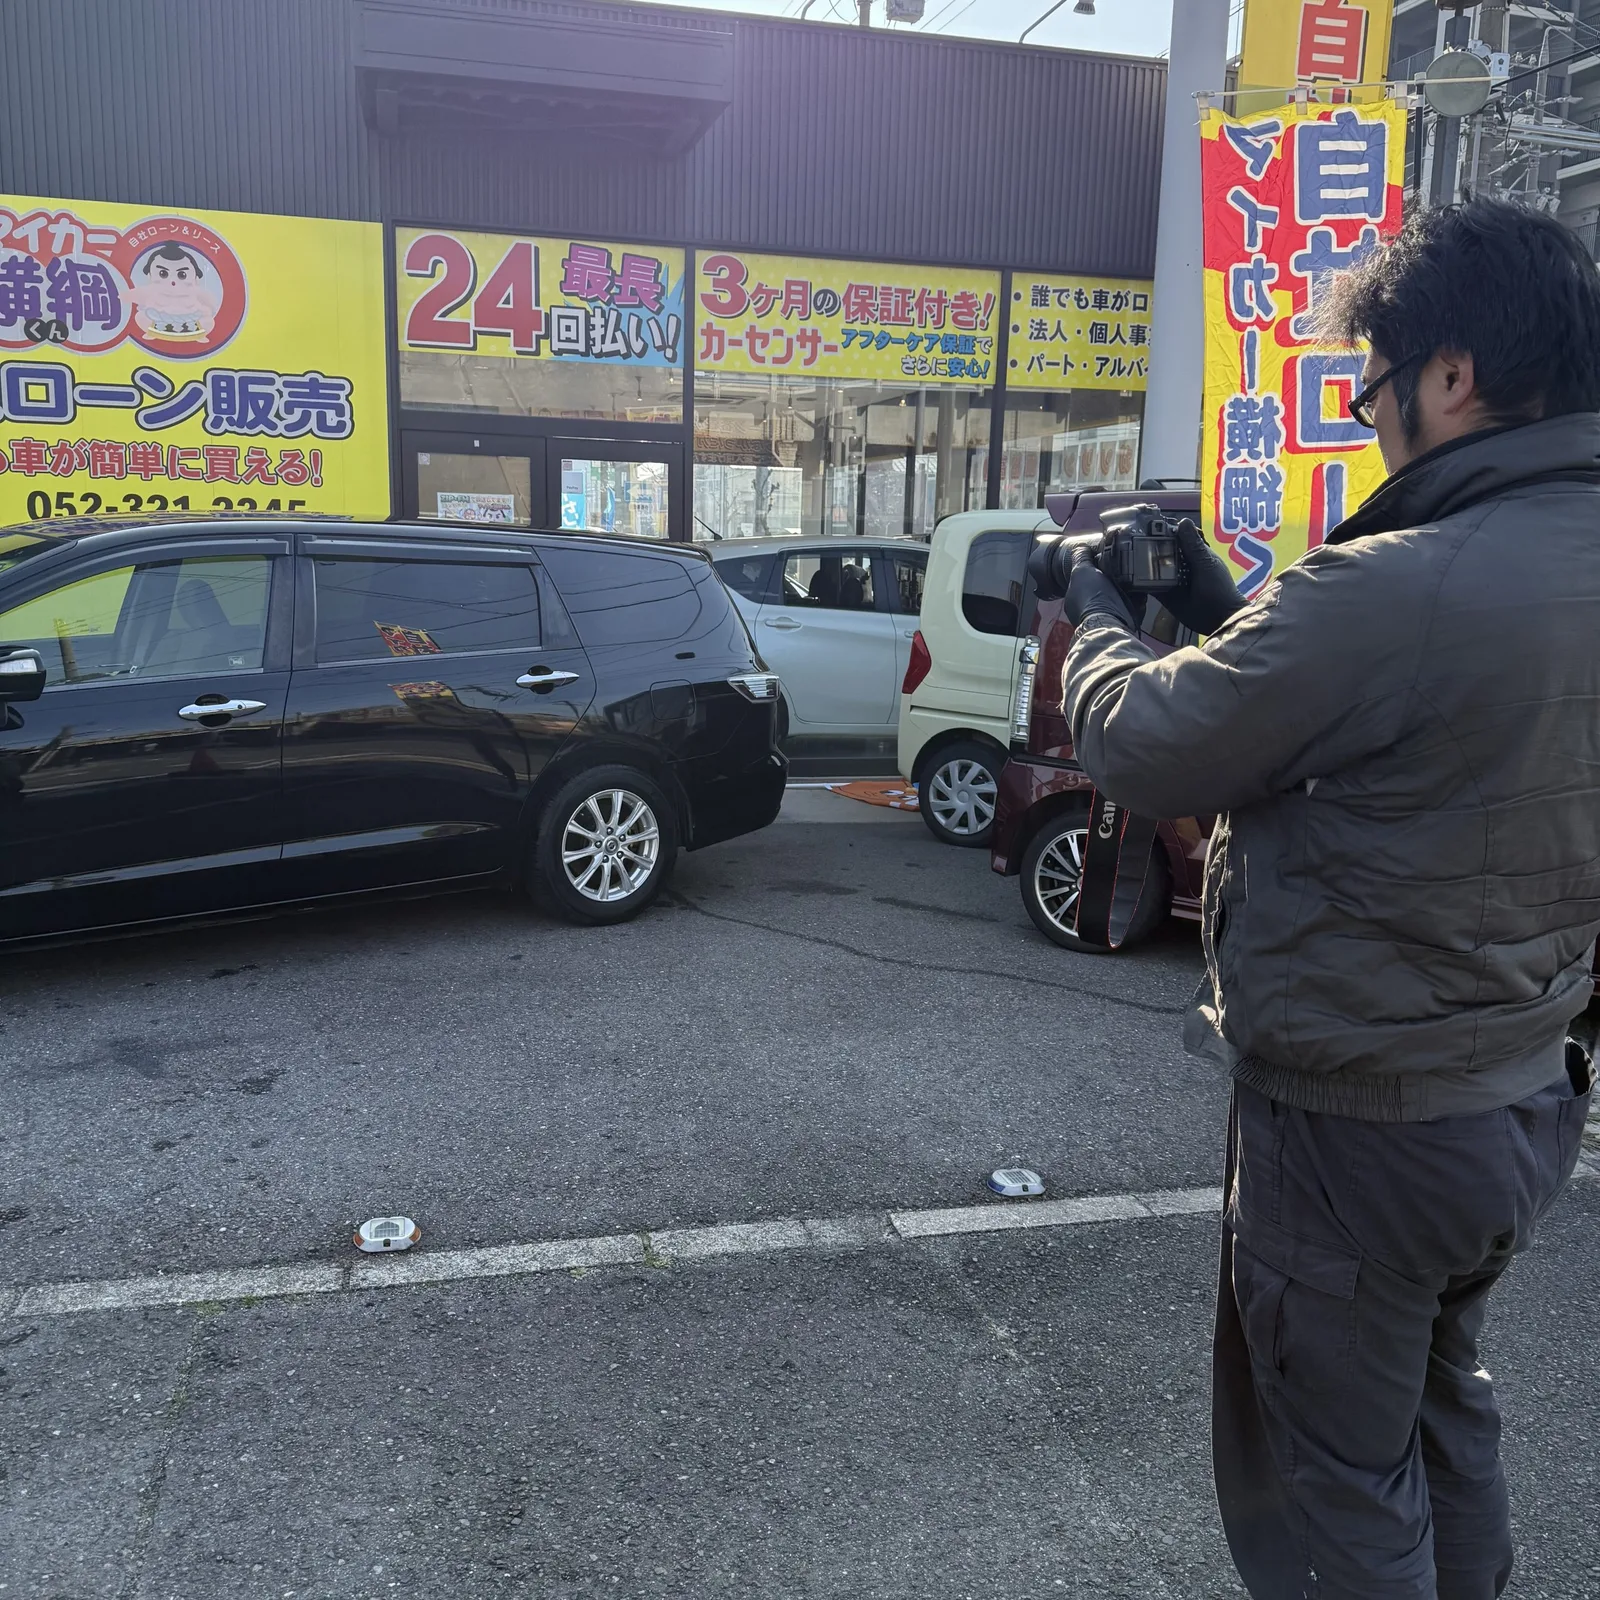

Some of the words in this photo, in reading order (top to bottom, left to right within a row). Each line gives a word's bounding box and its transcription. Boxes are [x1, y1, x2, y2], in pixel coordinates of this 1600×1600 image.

[1291, 0, 1368, 102] 自
[128, 224, 221, 254] 自社ローン&リース
[560, 242, 664, 315] 最長
[404, 232, 550, 356] 24
[1031, 284, 1152, 312] 誰でも車がロ
[26, 319, 67, 343] くん
[550, 305, 681, 363] 回払い!
[699, 321, 839, 367] カーセンサー
[840, 328, 992, 355] アフターケア保証で
[1028, 318, 1151, 347] 法人・個人事
[901, 355, 990, 378] さらに安心!
[1026, 353, 1148, 377] パート・アルバ
[2, 362, 353, 439] ローン販売
